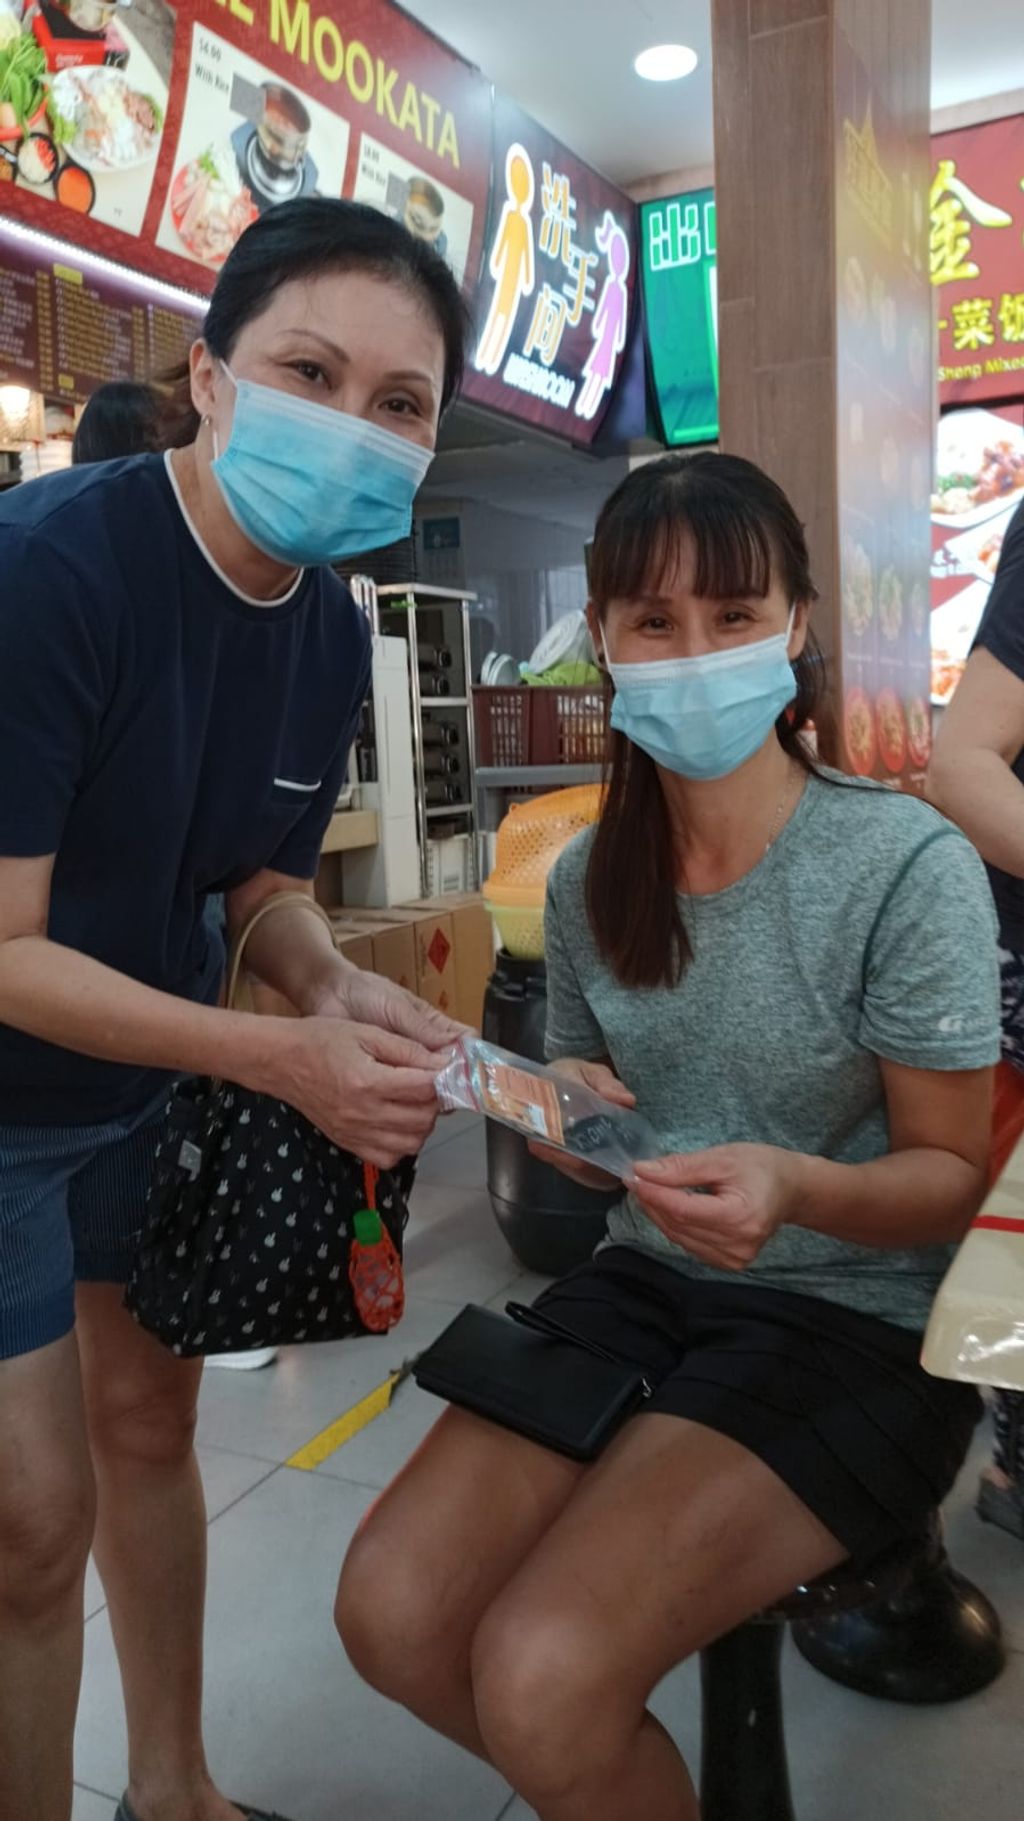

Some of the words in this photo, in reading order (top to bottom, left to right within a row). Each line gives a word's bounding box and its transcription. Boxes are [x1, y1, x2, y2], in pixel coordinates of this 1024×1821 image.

[270, 0, 460, 170] MOOKATA
[930, 160, 1024, 286] 金
[938, 293, 1024, 351] 菜饭
